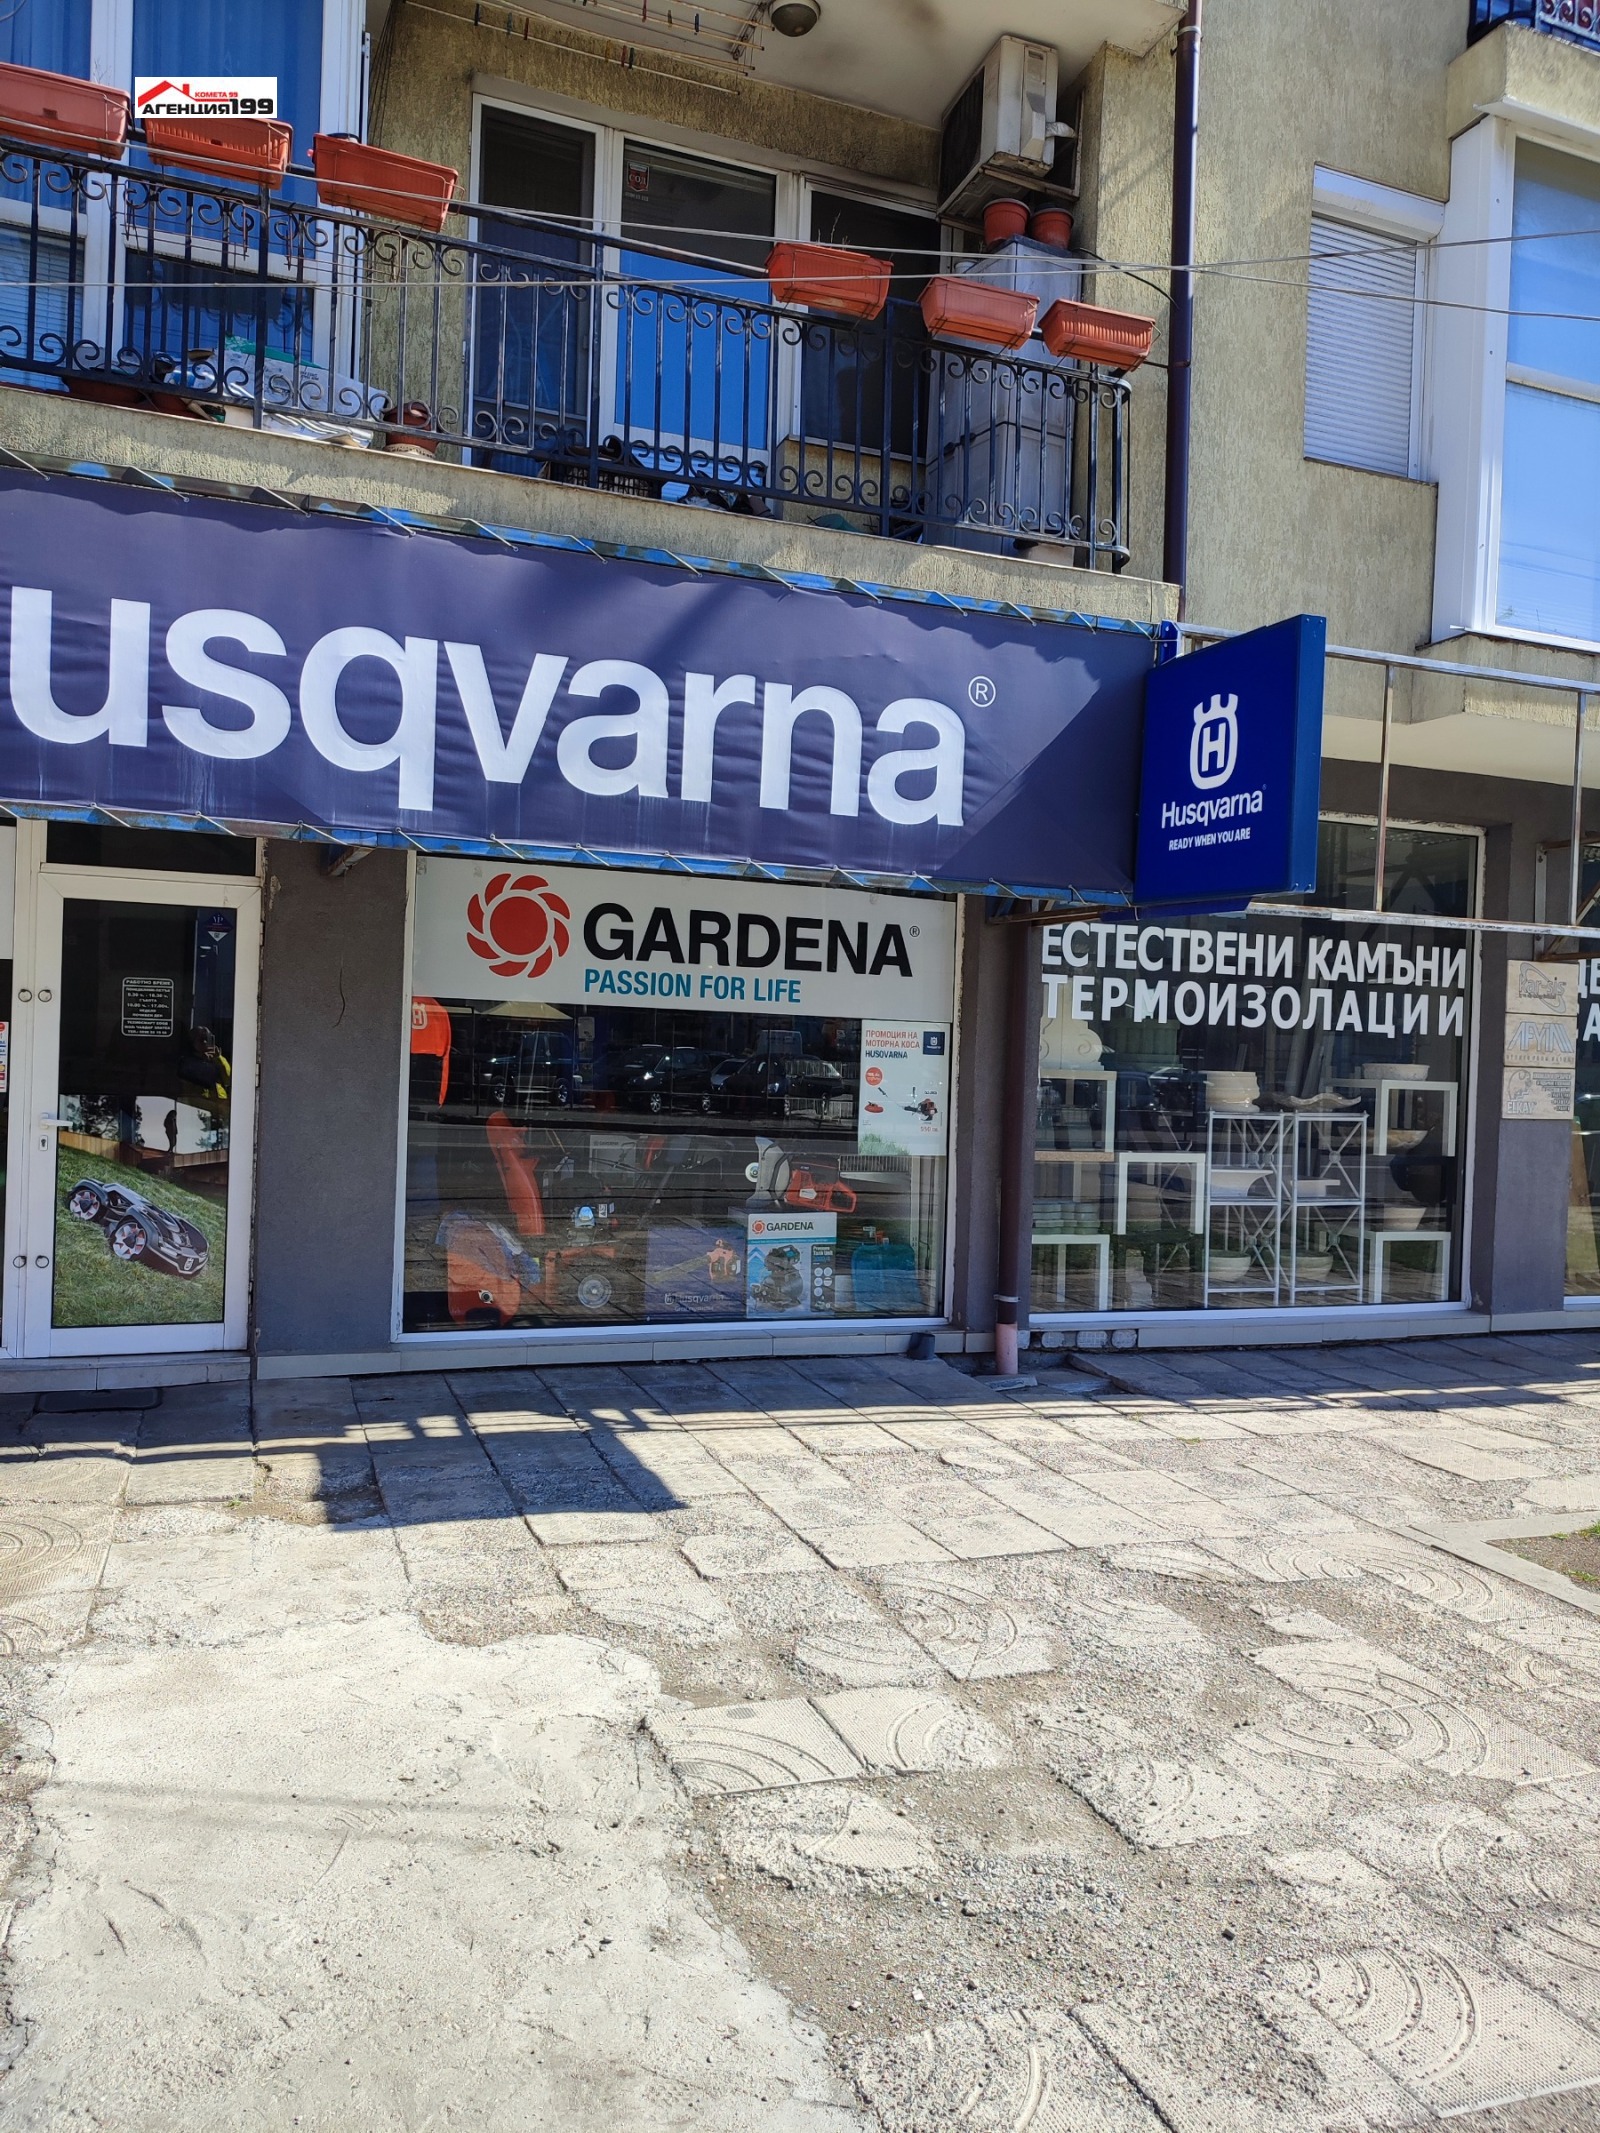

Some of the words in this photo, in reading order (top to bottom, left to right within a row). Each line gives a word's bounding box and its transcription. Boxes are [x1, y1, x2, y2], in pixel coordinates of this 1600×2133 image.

[9, 585, 966, 827] usqvarna
[1161, 790, 1263, 829] Husqvarna
[1168, 836, 1194, 851] READY
[1194, 833, 1217, 847] WHEN
[1218, 830, 1235, 843] YOU
[1235, 827, 1251, 841] ARE
[583, 902, 913, 978] GARDENA
[1041, 921, 1294, 979] ЕСТЕСТВЕНИ
[1307, 937, 1467, 989] КАМЪНИ
[584, 968, 692, 998] PASSION
[700, 975, 745, 1001] FOR
[754, 978, 802, 1003] LIFE
[1041, 973, 1464, 1038] ТЕРМОИЗОЛАЦИИ
[865, 1029, 906, 1039] ПРОМОЦИЯ
[907, 1031, 918, 1039] НА
[865, 1039, 900, 1048] МОТОРНА
[901, 1040, 920, 1049] КОСА
[766, 1222, 814, 1232] GARDENA
